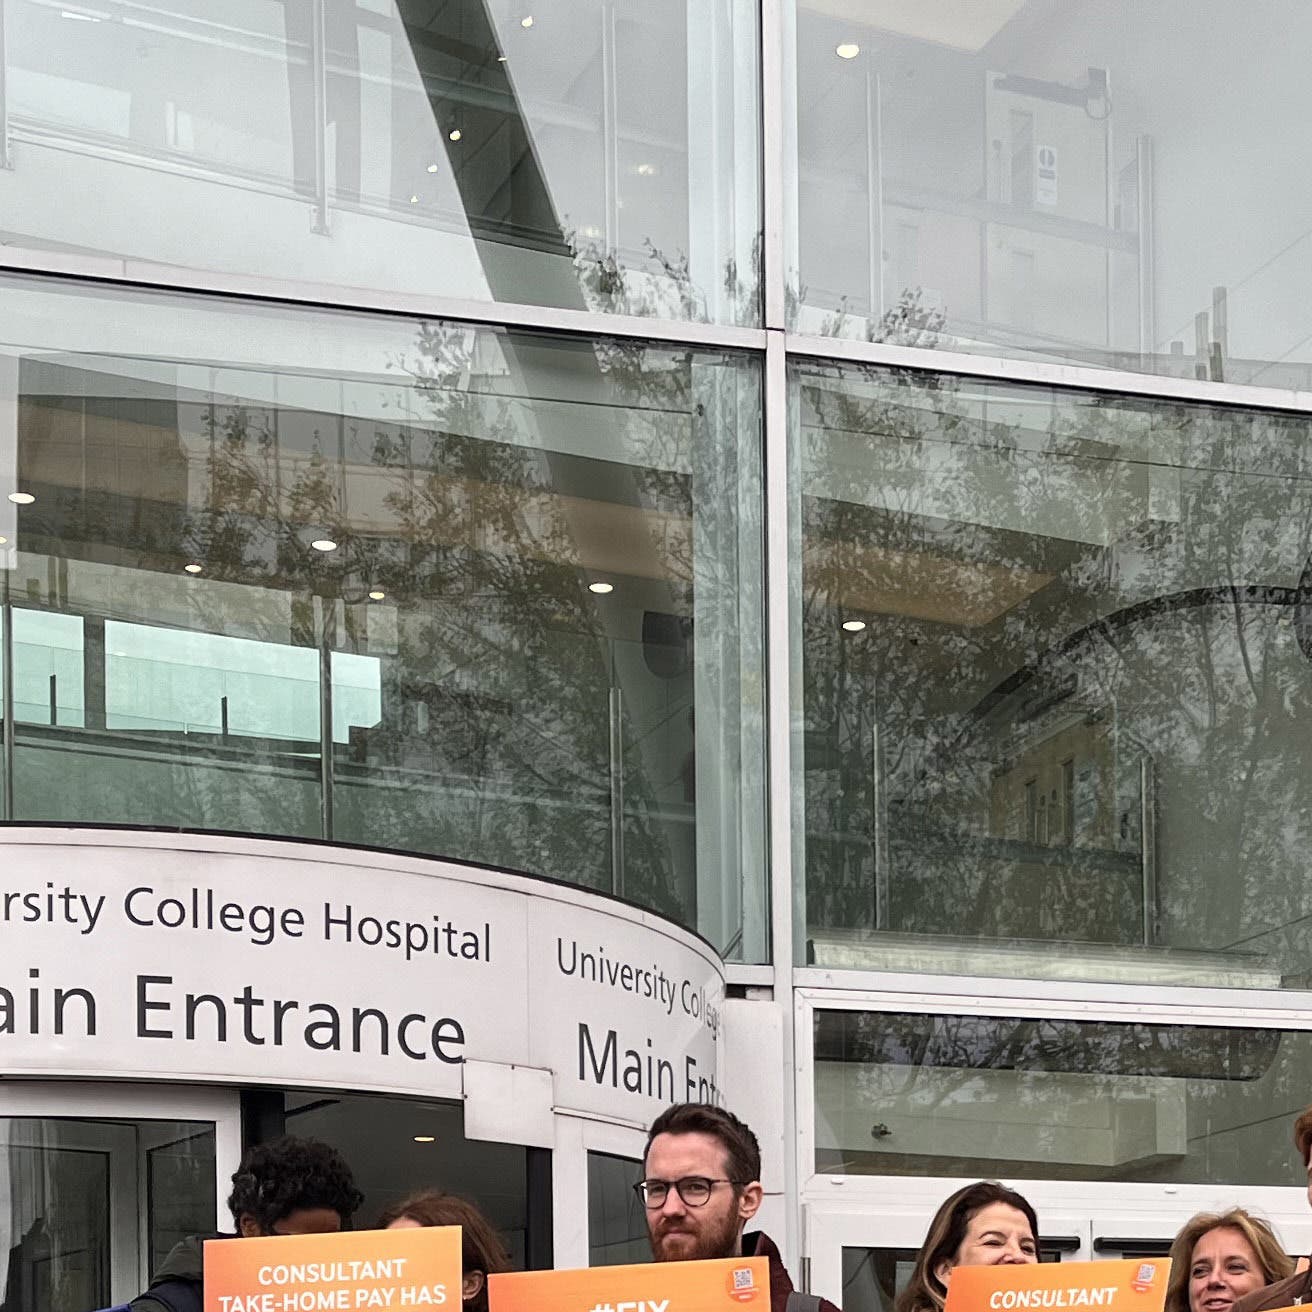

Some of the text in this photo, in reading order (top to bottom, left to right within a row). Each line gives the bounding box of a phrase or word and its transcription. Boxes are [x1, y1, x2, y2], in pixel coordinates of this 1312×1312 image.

[125, 887, 304, 945] College
[325, 903, 489, 962] Hospital
[558, 938, 676, 1015] University
[137, 975, 467, 1063] Entrance
[578, 1022, 722, 1106] Main Entr
[259, 1259, 406, 1285] CONSULTANT
[356, 1288, 395, 1307] PAY
[401, 1285, 446, 1305] HAS
[990, 1288, 1117, 1308] CONSULTANT
